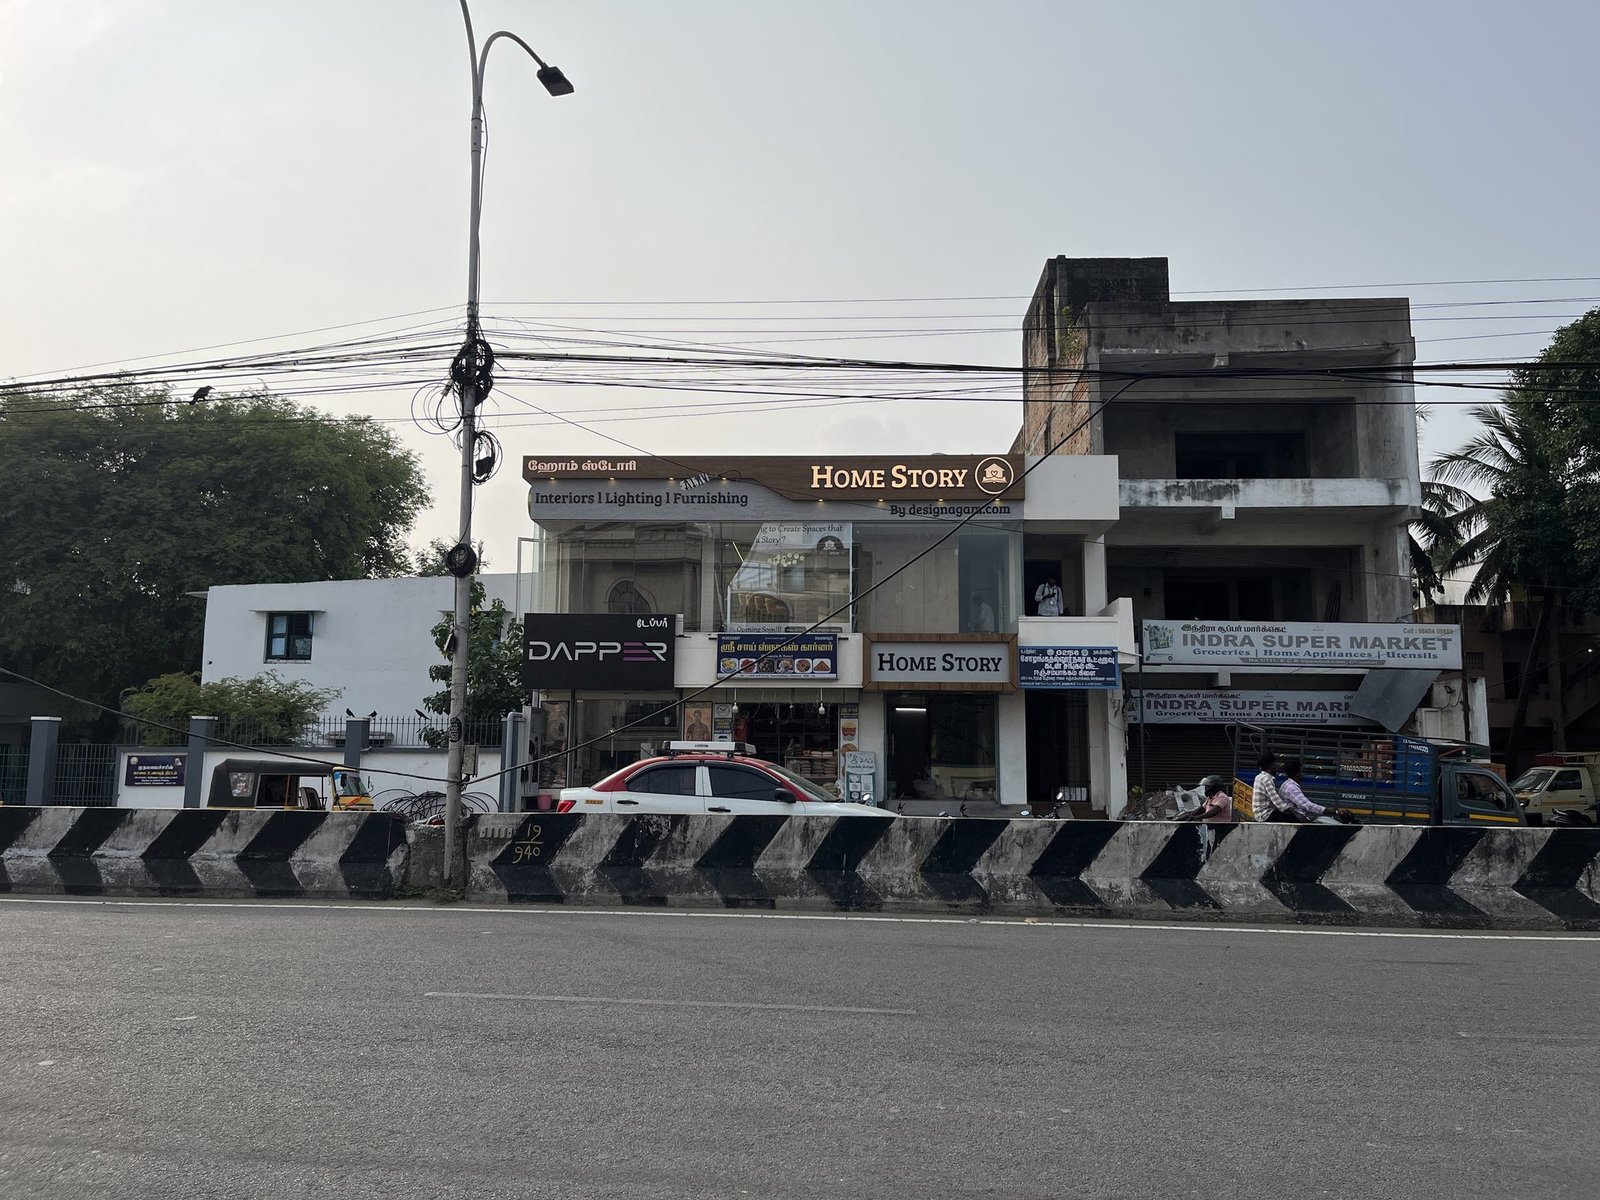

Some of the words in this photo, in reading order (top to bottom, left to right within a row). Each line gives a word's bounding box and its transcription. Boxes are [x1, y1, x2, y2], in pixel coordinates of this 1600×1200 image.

[528, 460, 578, 474] ஹோம்
[582, 460, 636, 471] ஸ்டோரி
[811, 465, 885, 488] HOME
[891, 464, 968, 488] STORY
[535, 492, 594, 504] Interiors
[605, 492, 662, 507] Lighting
[674, 492, 748, 507] Furnishing
[890, 505, 906, 517] By
[909, 503, 1010, 517] designagam.com
[778, 524, 800, 532] Create
[802, 524, 827, 534] Spaces
[828, 524, 843, 532] that
[761, 536, 781, 545] Story
[1181, 624, 1216, 633] இந்திரா
[1217, 624, 1242, 633] சூப்பர்
[1243, 624, 1286, 633] மார்க்கெட்
[1183, 634, 1254, 647] INDRA
[1262, 634, 1342, 649] SUPER
[1350, 636, 1452, 651] MARKET
[529, 641, 667, 661] DAPPER
[1193, 648, 1250, 656] Groceries
[1264, 649, 1300, 657] Home
[1303, 650, 1373, 659] Appliances
[1386, 651, 1438, 660] Utensils
[878, 653, 936, 671] HOME
[942, 653, 1002, 672] STORY
[1146, 700, 1212, 710] INDRA
[1219, 700, 1289, 711] SUPER
[526, 823, 542, 841] 19
[512, 845, 541, 864] 940
